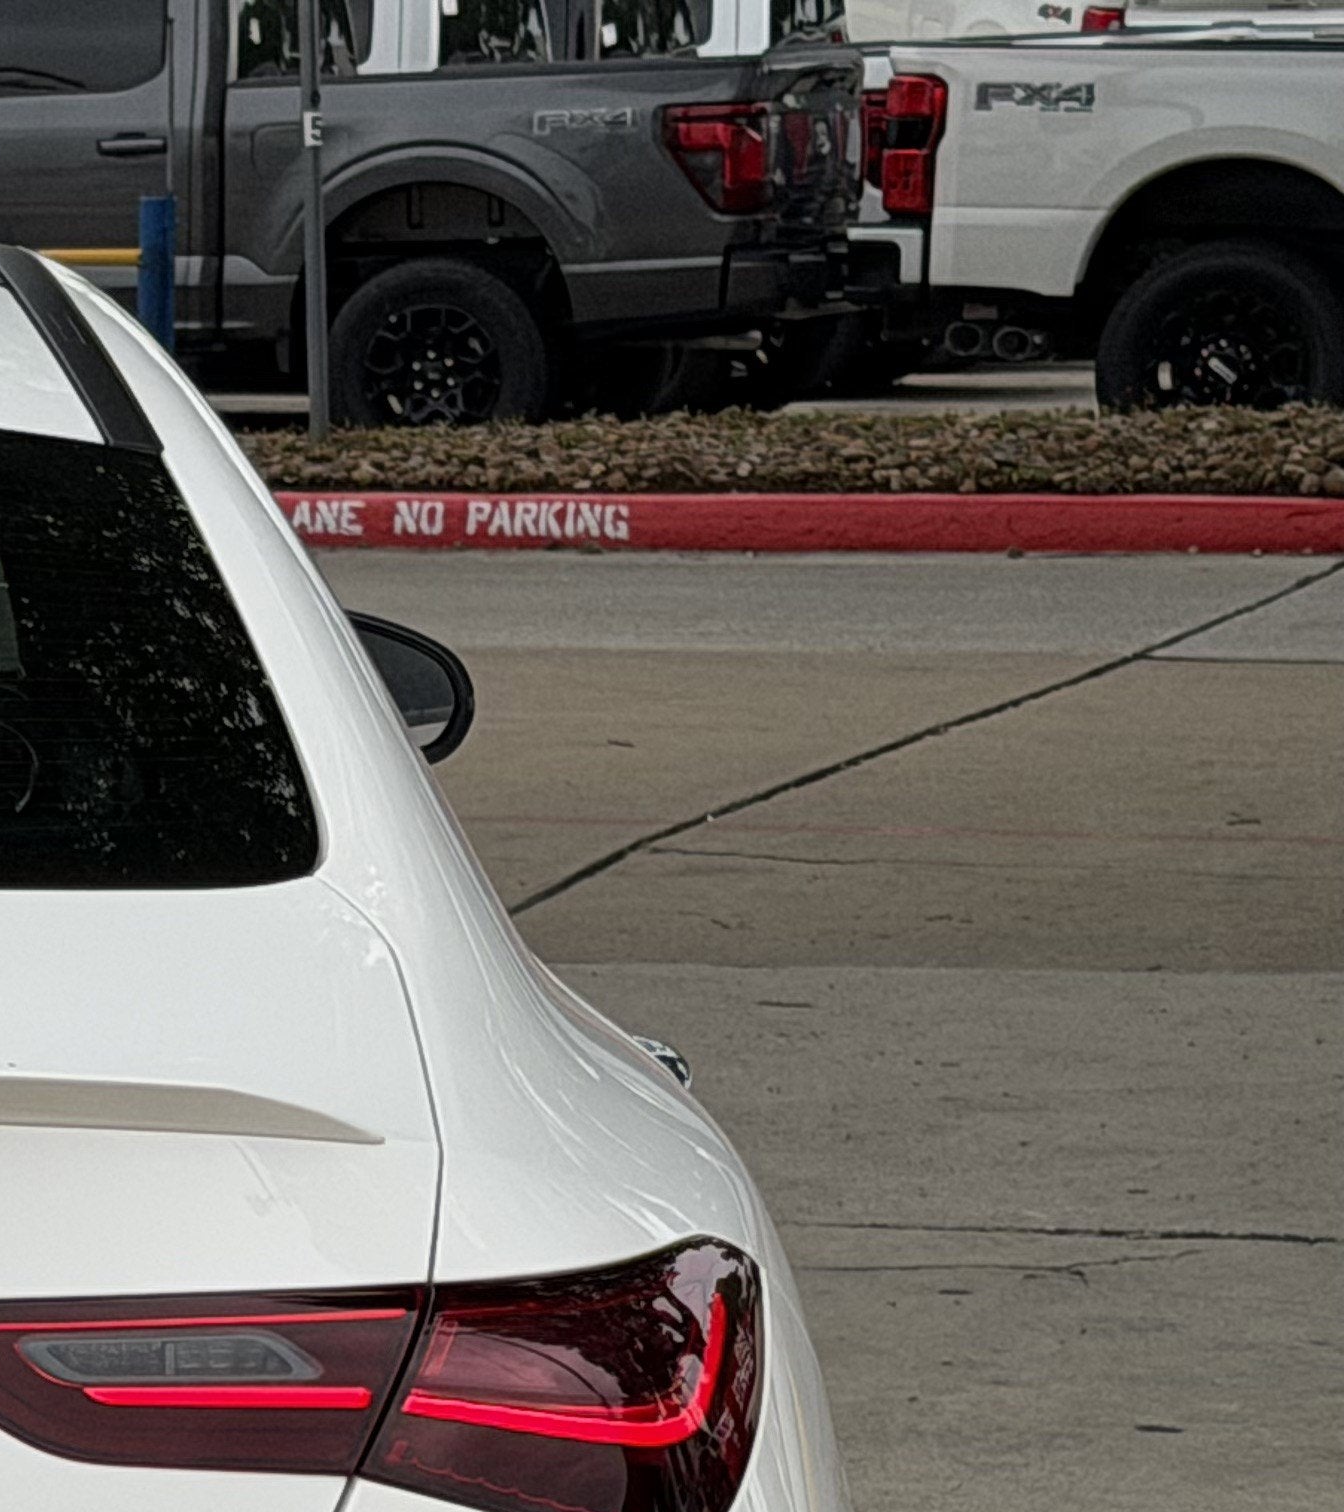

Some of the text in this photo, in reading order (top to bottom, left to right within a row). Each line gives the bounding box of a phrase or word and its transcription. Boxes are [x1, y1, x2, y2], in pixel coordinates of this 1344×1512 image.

[974, 82, 1095, 112] FX4
[291, 499, 630, 540] ANE NO PARKING
